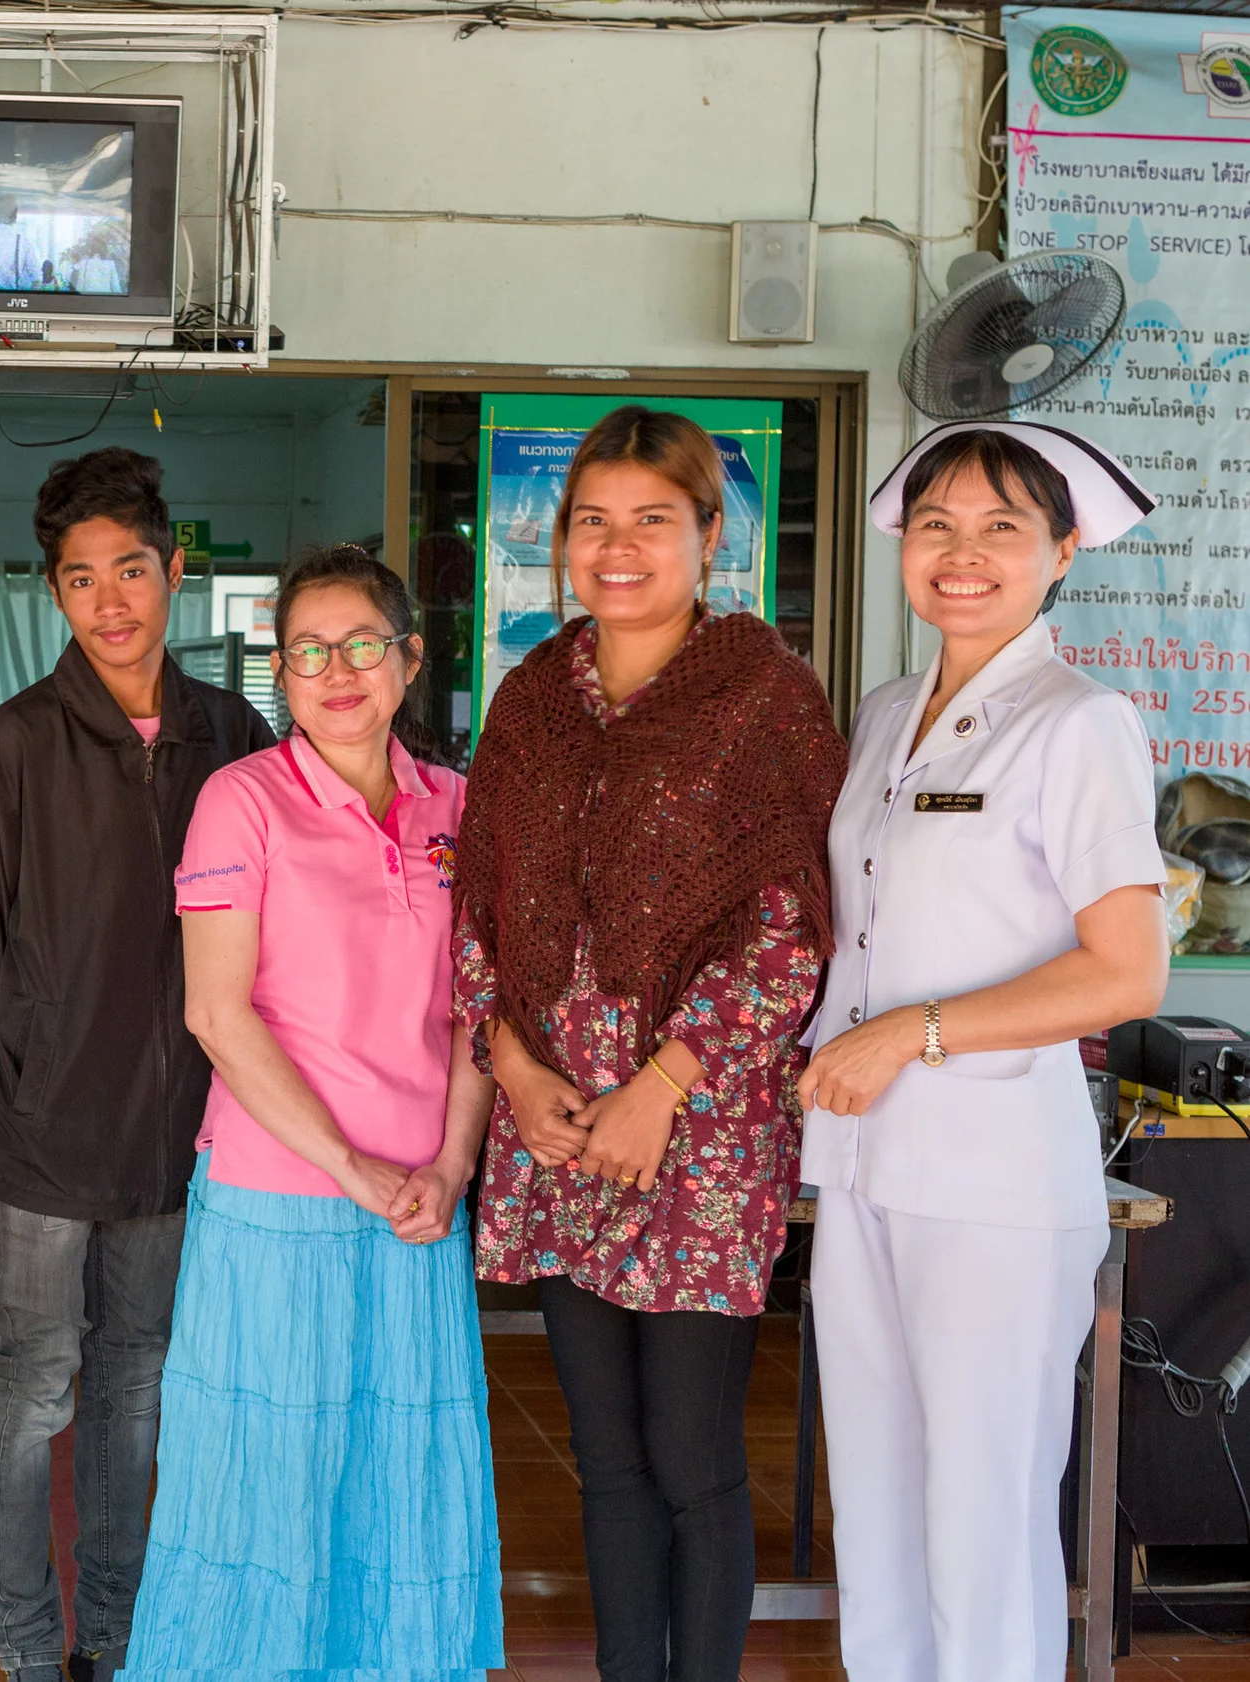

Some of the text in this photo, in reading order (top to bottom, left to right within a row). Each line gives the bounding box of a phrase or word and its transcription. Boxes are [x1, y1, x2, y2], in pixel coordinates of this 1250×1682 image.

[1014, 230, 1056, 249] (ONE
[1076, 233, 1129, 251] STOP
[1149, 235, 1232, 257] SERVICE)
[6, 298, 28, 308] JVC
[1125, 356, 1231, 383] รับยาต่อเนื่อง
[179, 524, 194, 547] 5
[1191, 689, 1250, 714] 255
[208, 863, 247, 878] Hospital
[437, 878, 452, 889] AS
